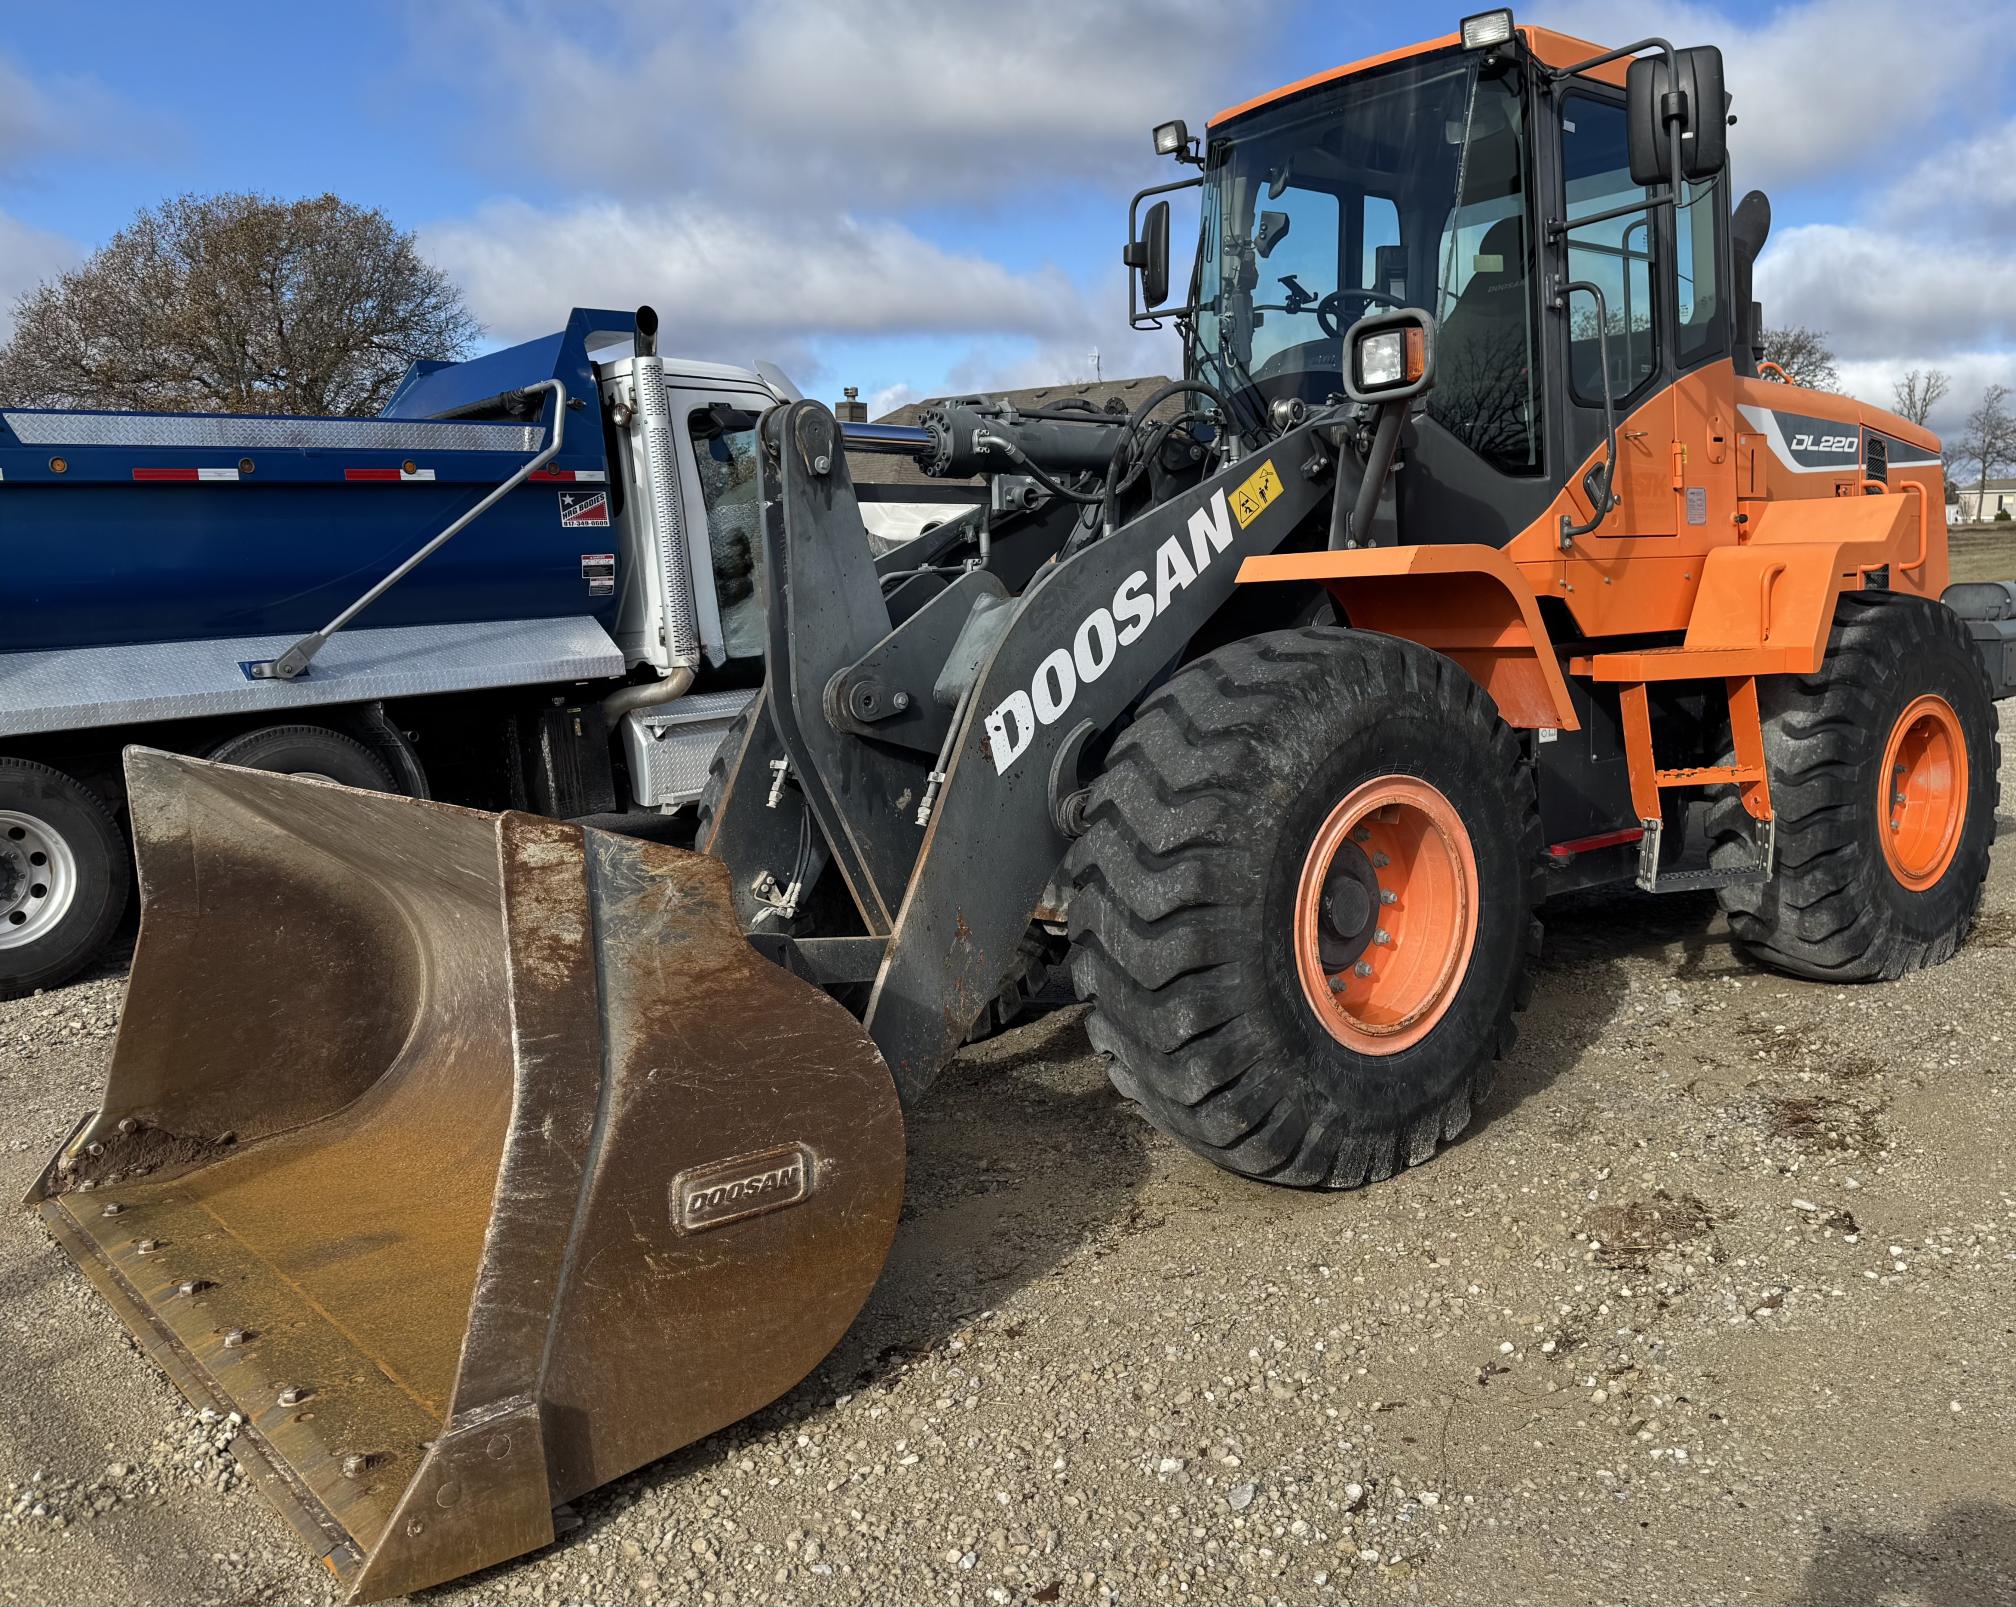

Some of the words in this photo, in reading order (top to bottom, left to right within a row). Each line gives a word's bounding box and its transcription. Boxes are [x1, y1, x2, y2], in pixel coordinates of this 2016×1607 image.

[1790, 434, 1859, 453] DL220
[578, 493, 605, 512] BODIES
[984, 487, 1234, 776] DOOSAN
[688, 1167, 799, 1212] DOOSAN
